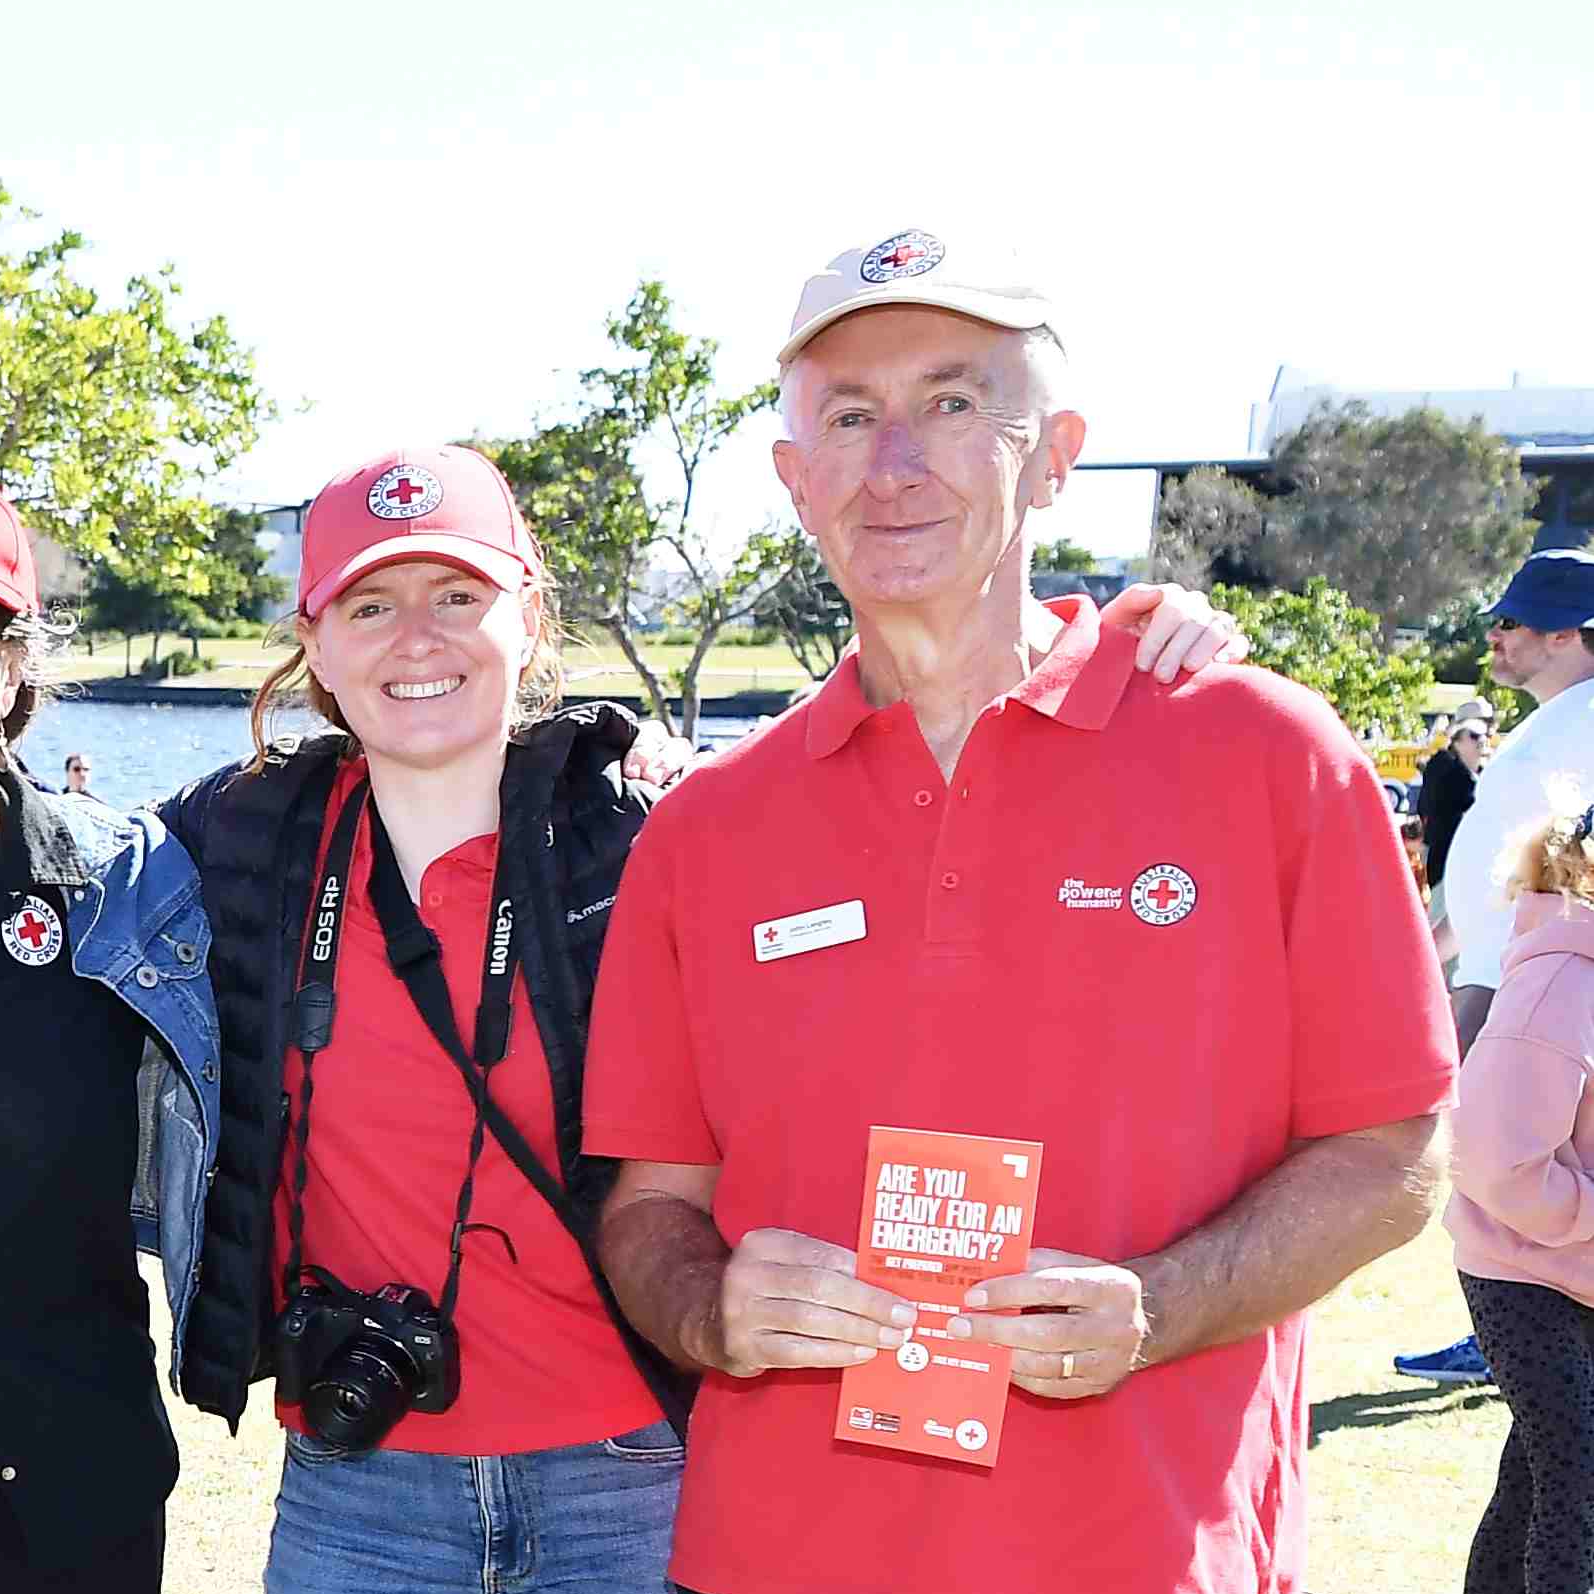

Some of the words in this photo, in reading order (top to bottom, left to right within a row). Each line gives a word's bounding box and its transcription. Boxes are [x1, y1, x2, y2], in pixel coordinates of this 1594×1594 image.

[321, 876, 340, 908] RP
[582, 895, 617, 918] mac
[1058, 887, 1112, 902] power
[313, 911, 335, 961] EOS
[489, 899, 513, 975] Canon
[875, 1162, 919, 1195] ARE
[923, 1167, 967, 1199] YOU
[874, 1191, 942, 1226] READY
[945, 1199, 988, 1231] FOR
[990, 1204, 1023, 1236] AN
[870, 1220, 1005, 1262] EMERGENCY?
